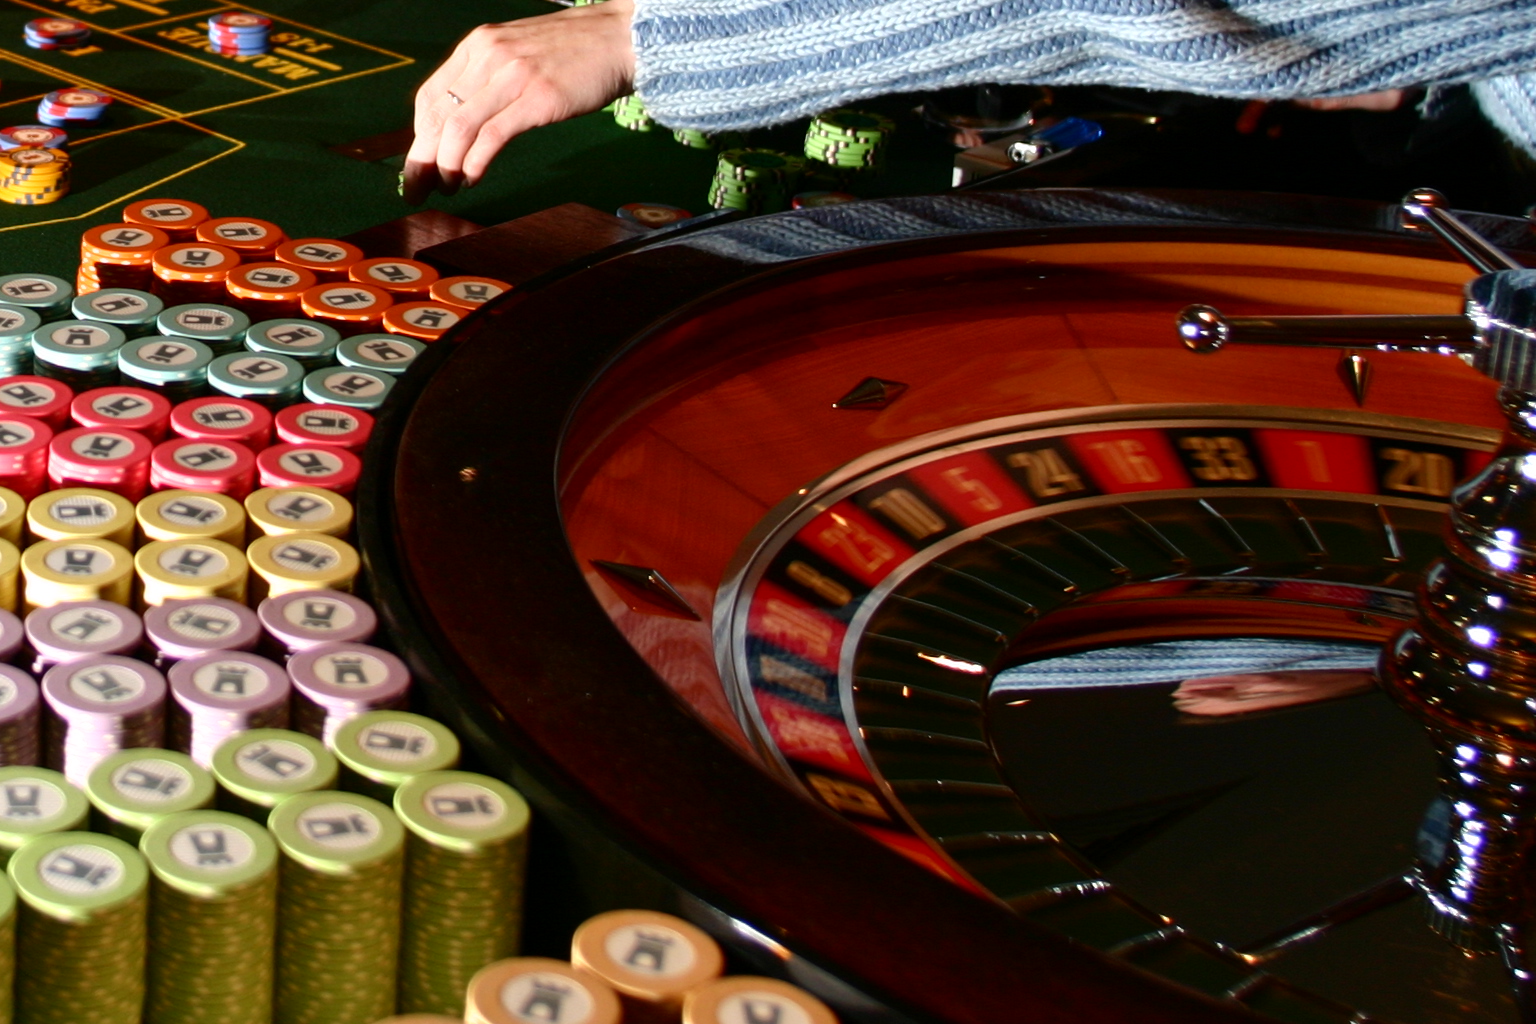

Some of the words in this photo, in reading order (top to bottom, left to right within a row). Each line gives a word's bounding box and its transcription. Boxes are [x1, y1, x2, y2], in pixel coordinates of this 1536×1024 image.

[1006, 447, 1084, 498] 24
[1086, 437, 1163, 486] 16
[1180, 435, 1257, 482] 33
[1294, 440, 1332, 484] 1
[1379, 447, 1455, 497] 20
[868, 487, 947, 540] 10
[944, 465, 1004, 513] 5
